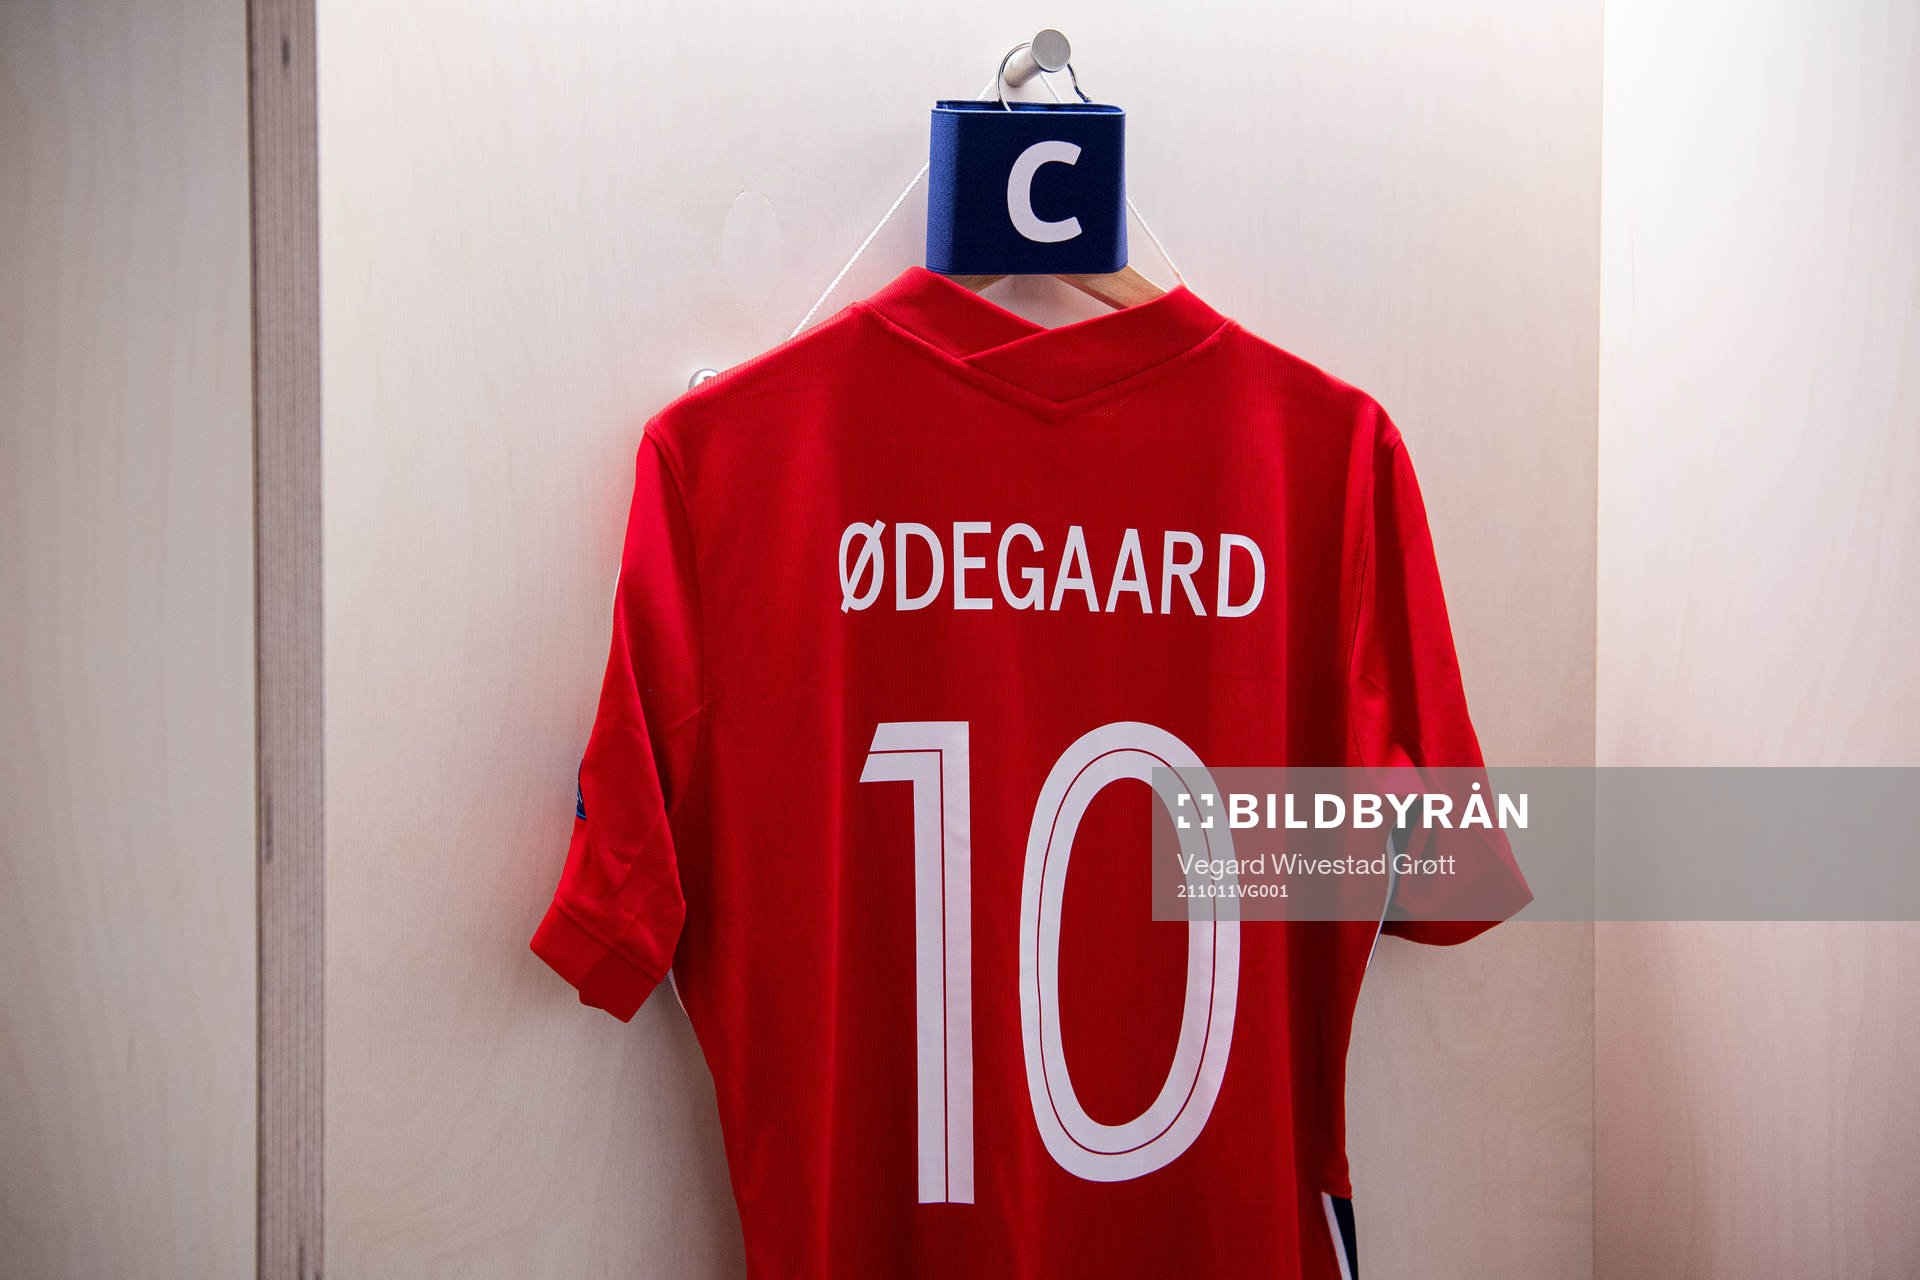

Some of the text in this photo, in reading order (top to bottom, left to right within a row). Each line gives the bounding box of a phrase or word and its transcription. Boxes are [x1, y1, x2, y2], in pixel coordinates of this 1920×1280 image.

[1007, 140, 1082, 243] C
[838, 519, 1267, 618] ØDEGAARD
[859, 721, 1241, 1205] 10
